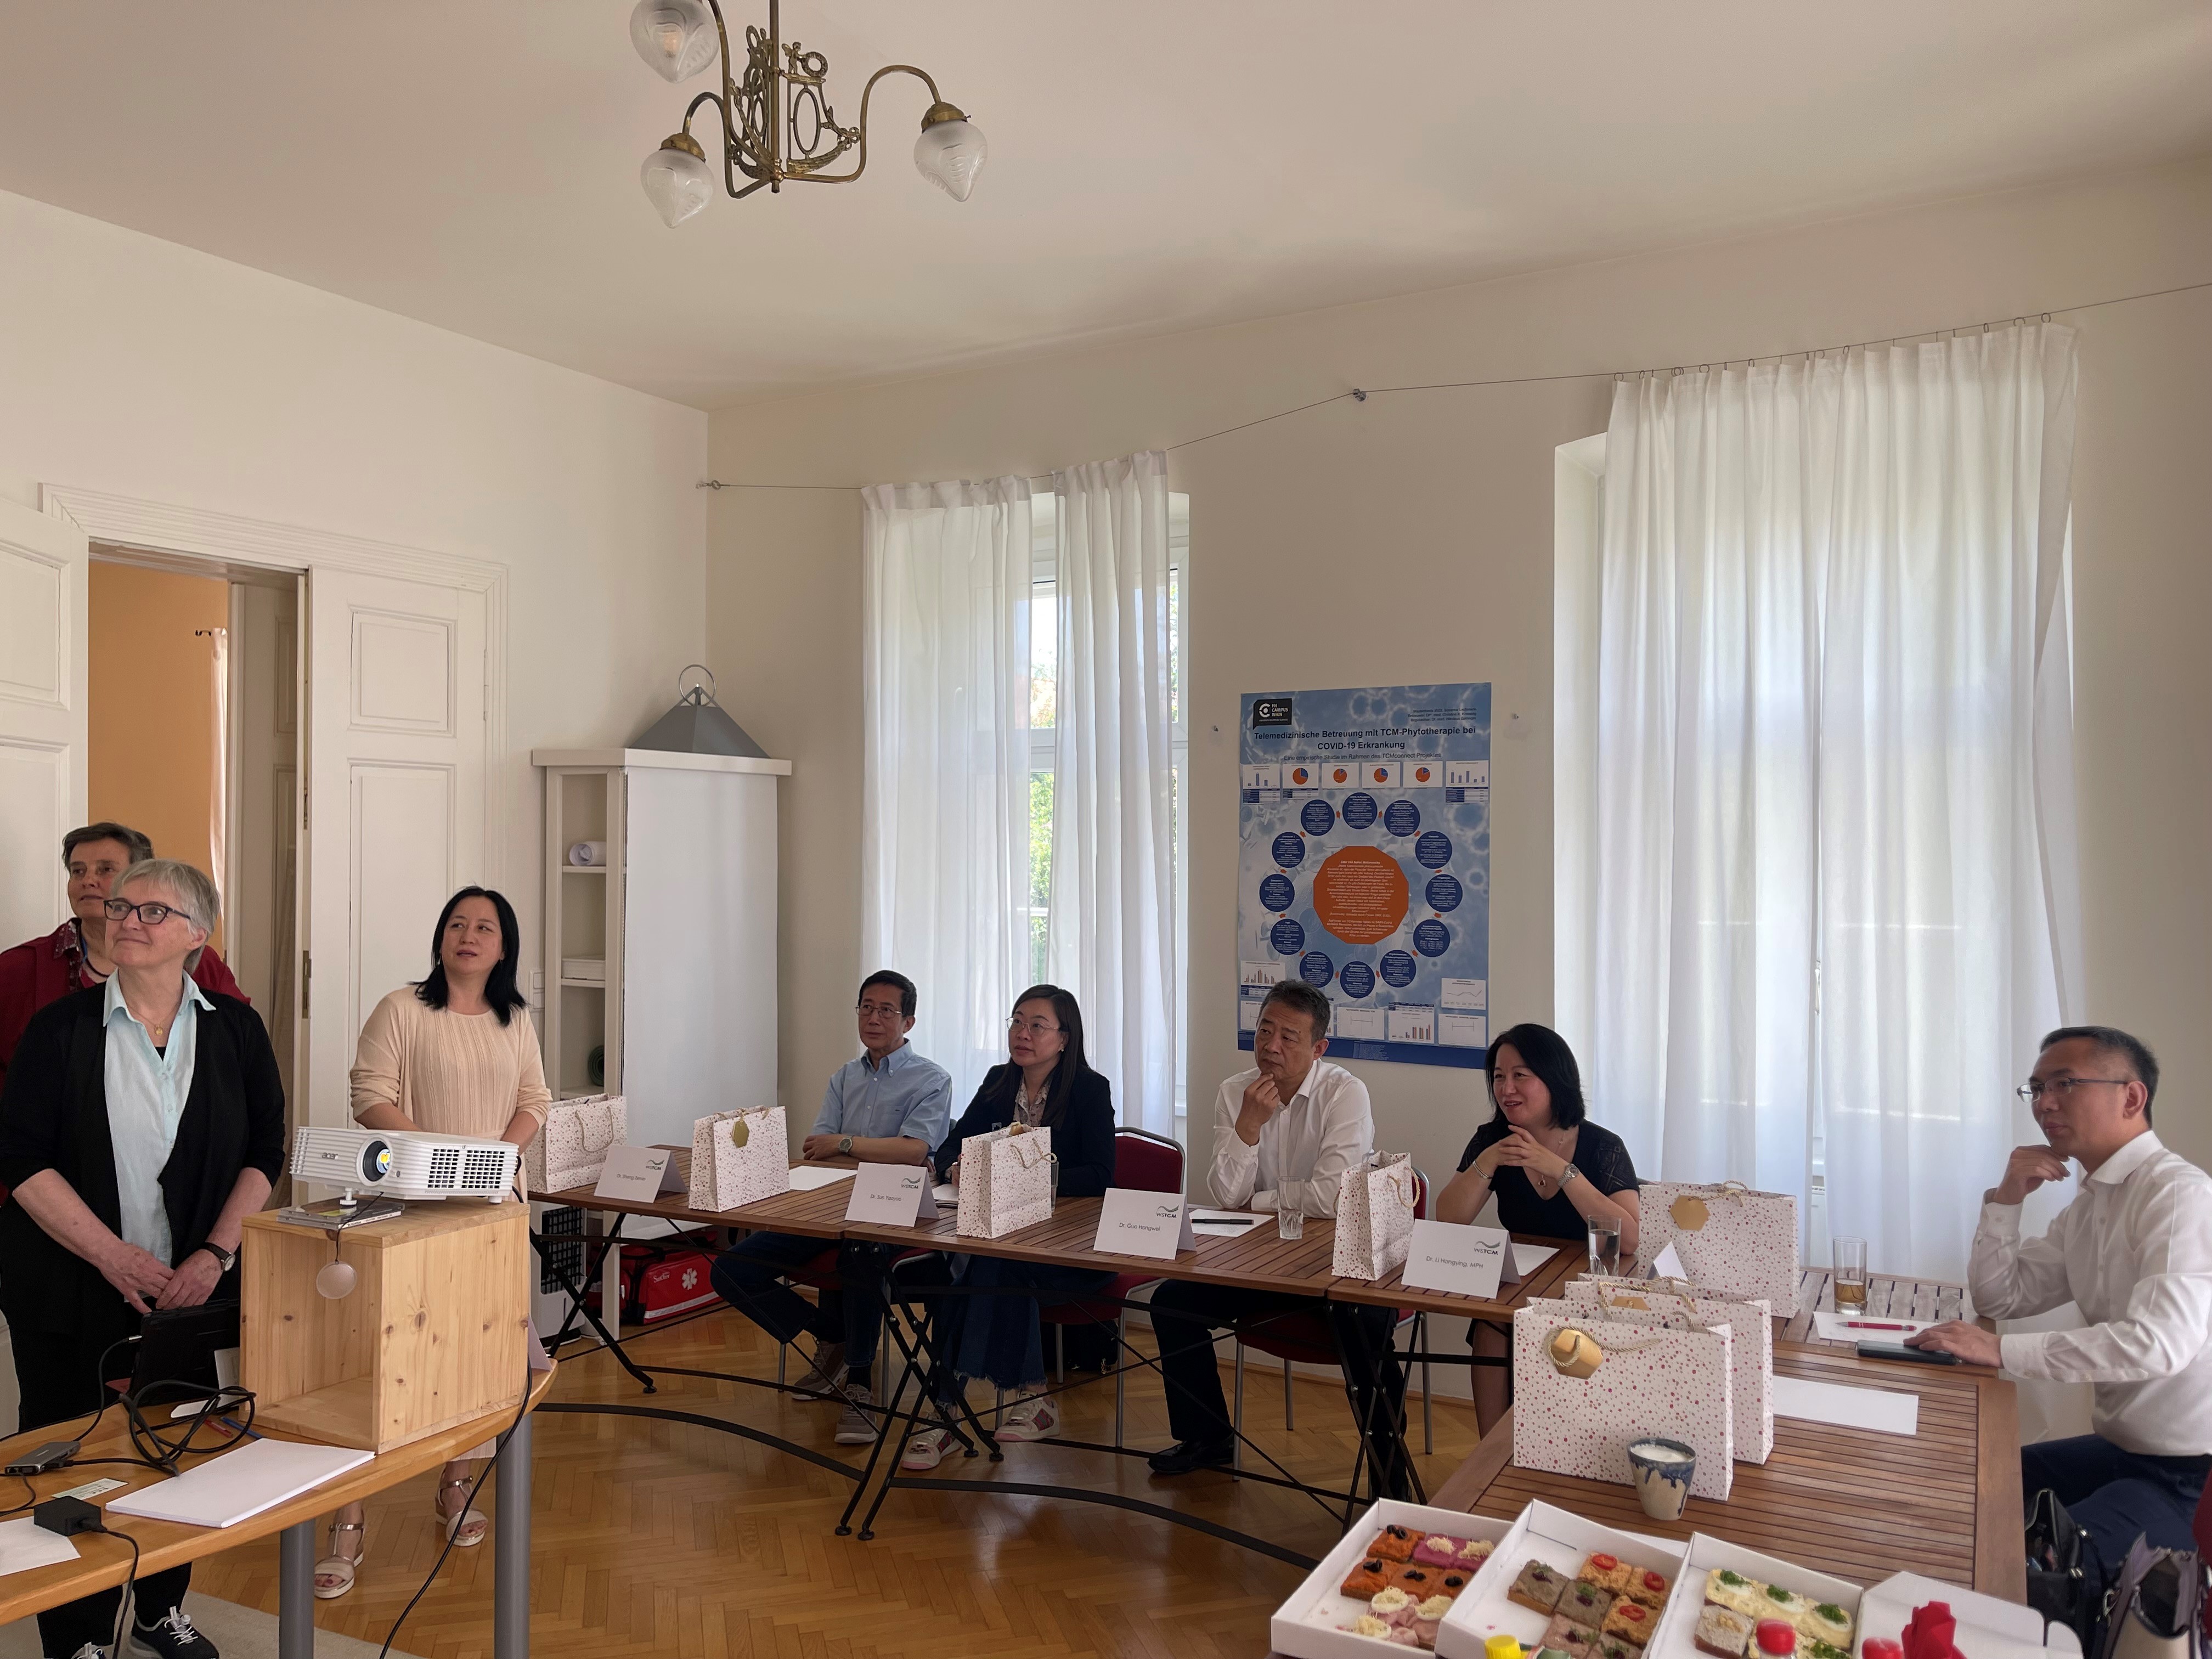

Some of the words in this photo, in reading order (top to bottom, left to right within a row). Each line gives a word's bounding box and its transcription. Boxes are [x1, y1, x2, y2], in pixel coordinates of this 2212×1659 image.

[1255, 731, 1319, 740] Telemedizinische
[1322, 730, 1363, 738] Betreuung
[1380, 727, 1460, 737] TCM-Phytotherapie
[1358, 741, 1405, 749] Erkrankung
